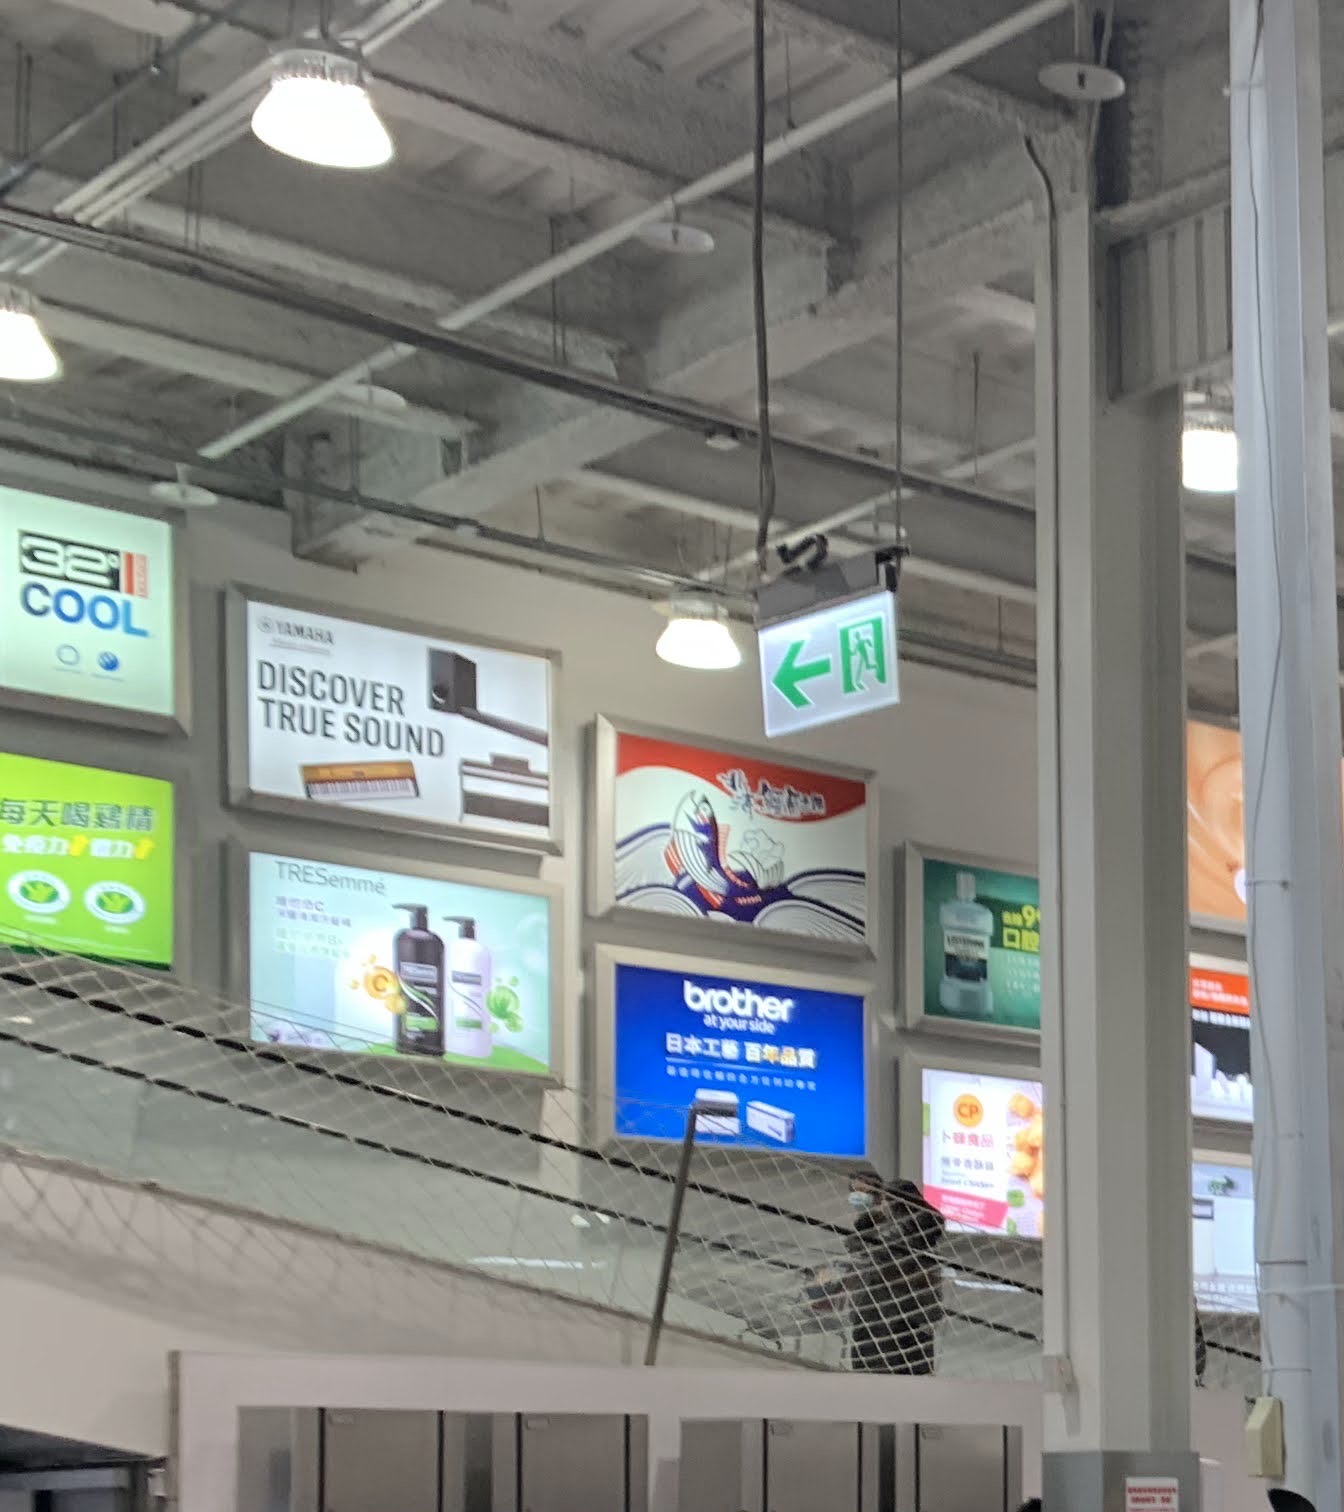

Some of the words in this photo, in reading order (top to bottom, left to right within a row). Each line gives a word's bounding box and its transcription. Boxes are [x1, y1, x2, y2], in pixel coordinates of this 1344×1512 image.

[20, 582, 150, 638] COOL
[276, 618, 335, 647] YAMAHA
[258, 659, 405, 717] DISCOVER
[258, 695, 336, 740] TRUE
[344, 707, 445, 759] SOUND
[275, 860, 386, 897] TRESemmé
[682, 979, 795, 1022] brother
[703, 1014, 719, 1028] at
[719, 1017, 749, 1034] your
[749, 1018, 776, 1035] side
[744, 1040, 817, 1070] 百年品質
[957, 1102, 979, 1119] CP
